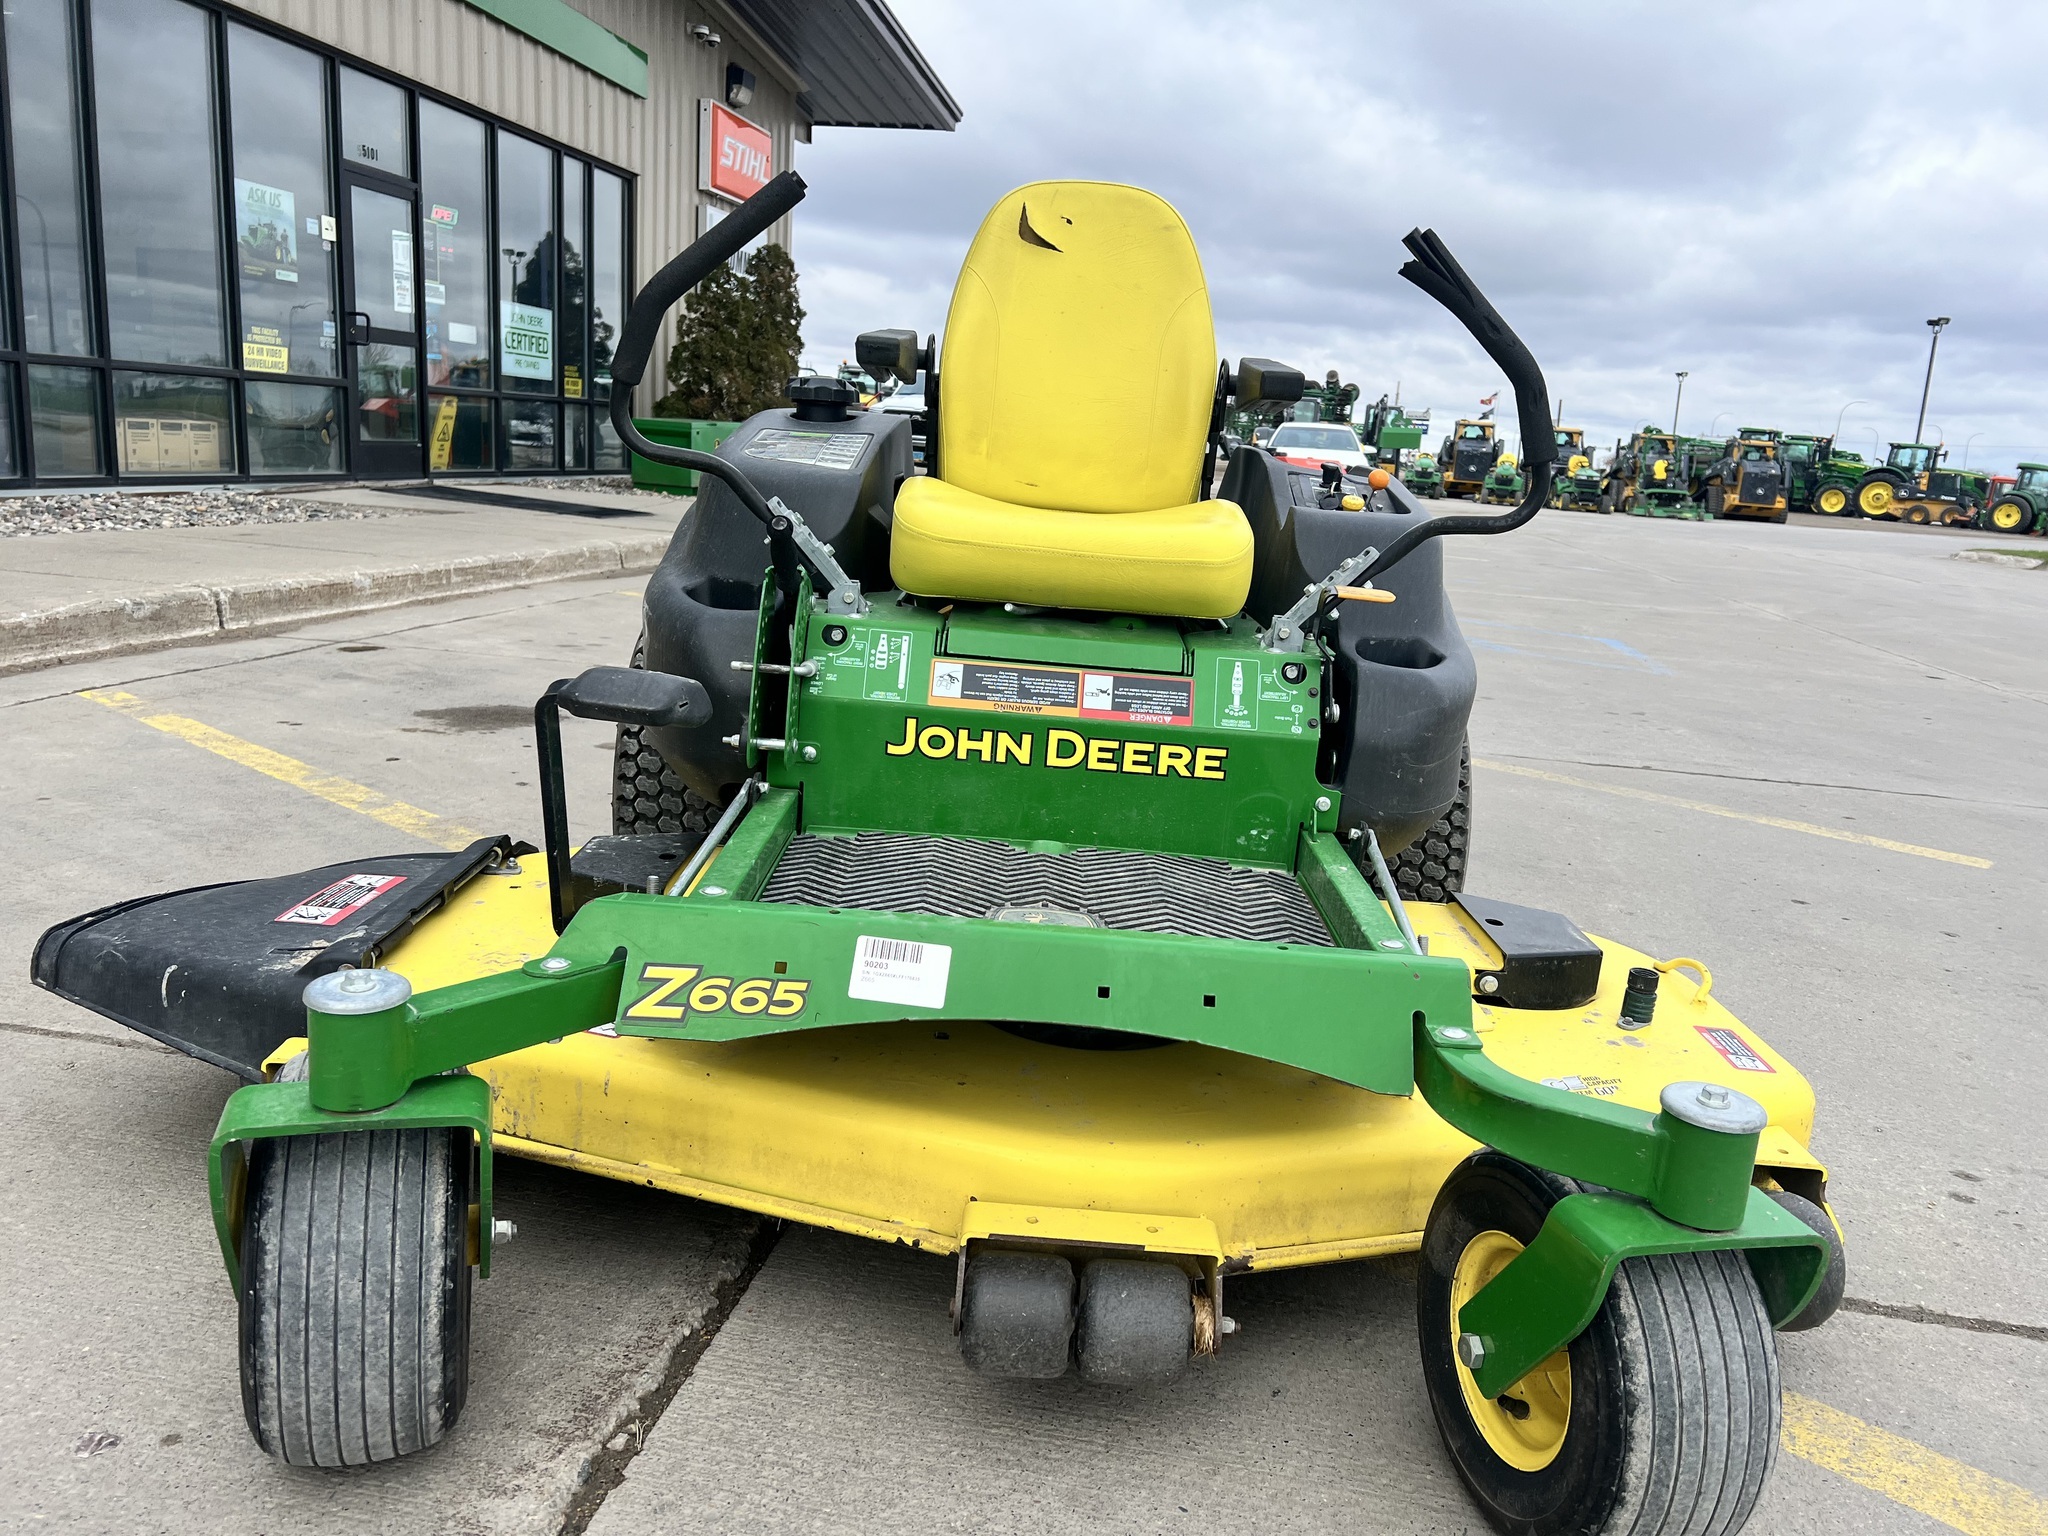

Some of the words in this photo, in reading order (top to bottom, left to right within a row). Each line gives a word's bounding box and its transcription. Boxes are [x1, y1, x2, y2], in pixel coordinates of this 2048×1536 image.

[720, 135, 769, 184] STIHL
[247, 186, 266, 202] ASK
[269, 191, 282, 208] US
[504, 331, 549, 354] CERTIFIED
[993, 703, 1035, 713] WARNING
[1129, 713, 1163, 723] DANGER
[885, 717, 1034, 766] JOHN
[1045, 727, 1229, 780] DEERE
[863, 960, 889, 970] 90203
[621, 962, 811, 1022] Z665
[1586, 1078, 1622, 1087] CAPACITY
